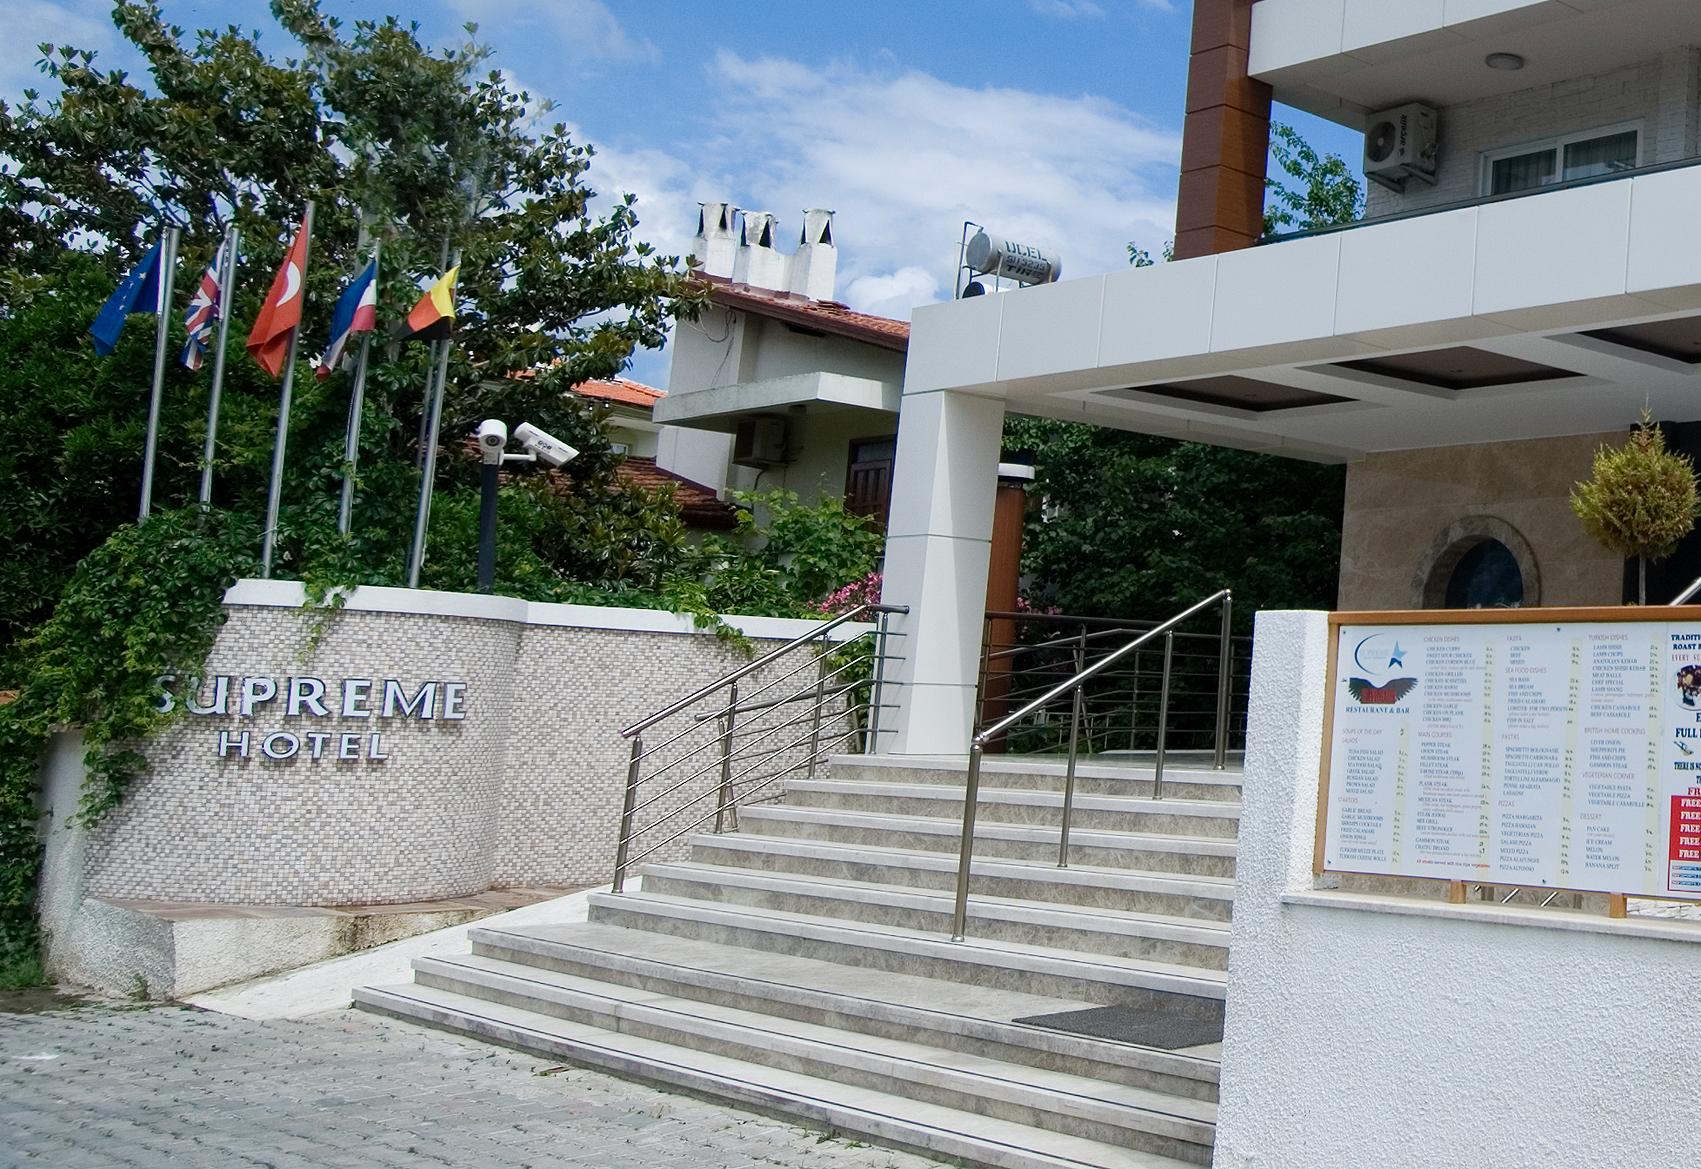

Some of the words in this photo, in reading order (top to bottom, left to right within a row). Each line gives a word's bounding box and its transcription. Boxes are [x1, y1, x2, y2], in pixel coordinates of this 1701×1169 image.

[154, 675, 467, 720] SUPREME
[1676, 728, 1698, 738] FULL
[218, 730, 388, 760] HOTEL
[1674, 762, 1689, 770] THERE
[1681, 799, 1701, 807] FREE
[1681, 812, 1701, 820] FREE
[1680, 824, 1700, 833] FREE
[1680, 837, 1700, 845] FREE
[1679, 850, 1699, 858] FREE
